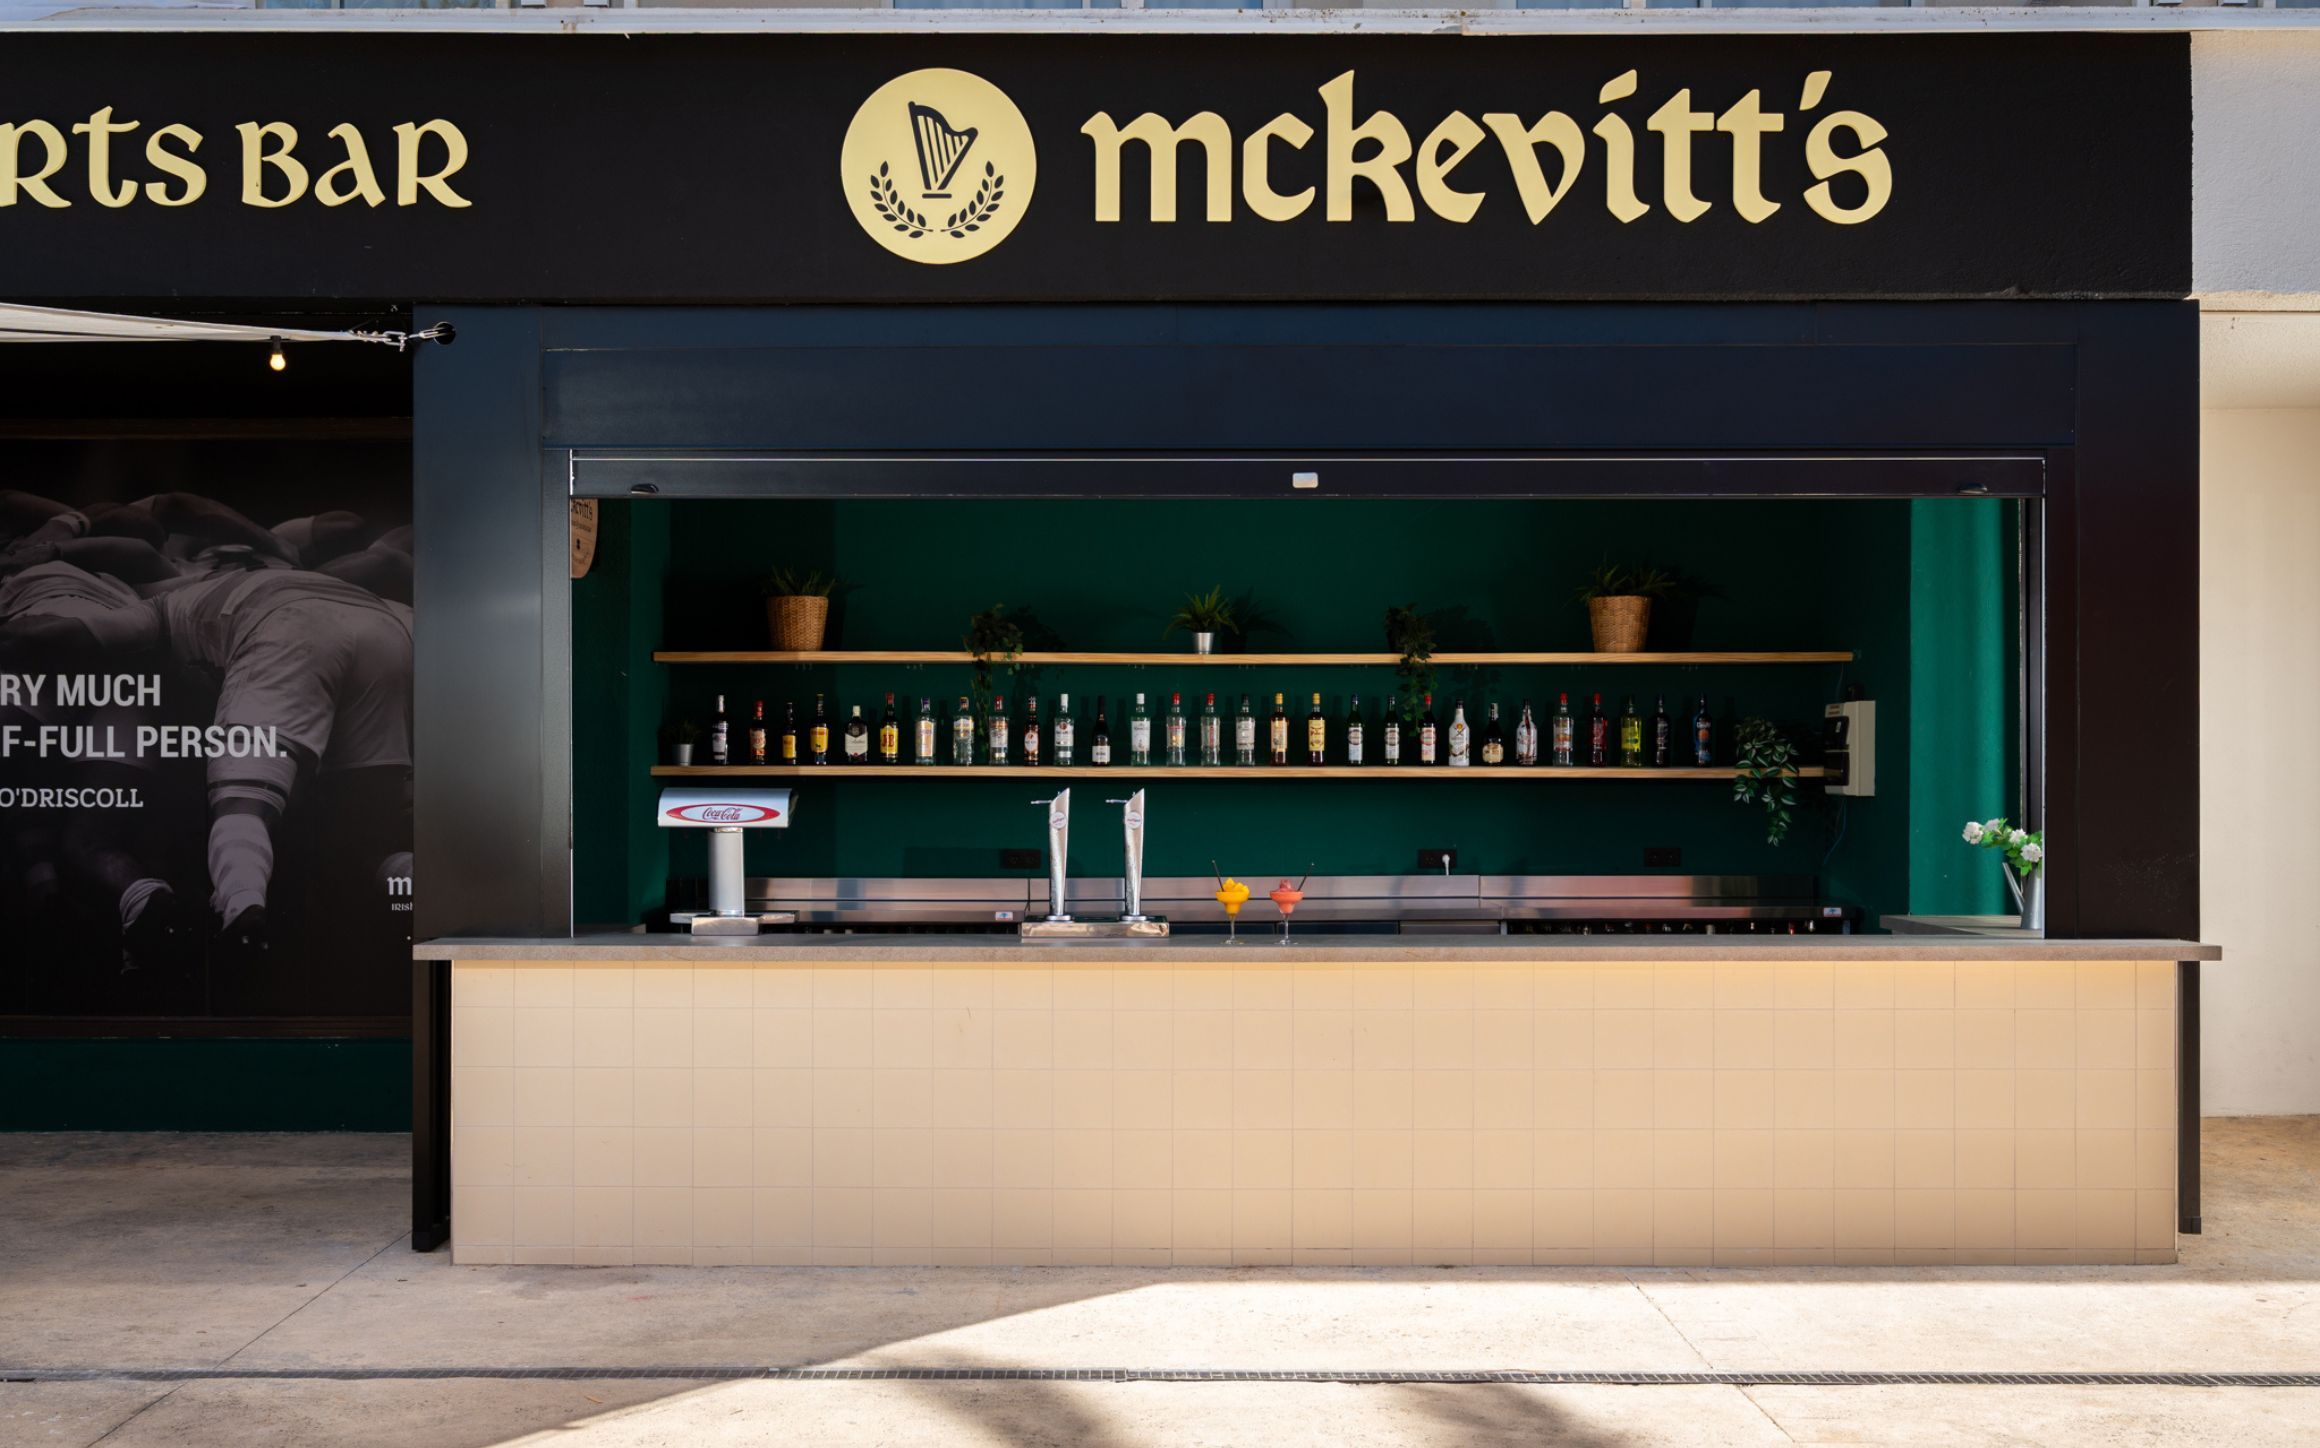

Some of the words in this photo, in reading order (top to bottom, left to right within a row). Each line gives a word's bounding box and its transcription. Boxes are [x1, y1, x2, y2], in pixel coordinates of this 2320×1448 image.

[1081, 70, 1893, 226] mckevitt's
[57, 674, 161, 707] MUCH
[0, 726, 126, 758] F-FULL
[137, 726, 288, 758] PERSON.
[0, 787, 144, 808] O'DRISCOLL
